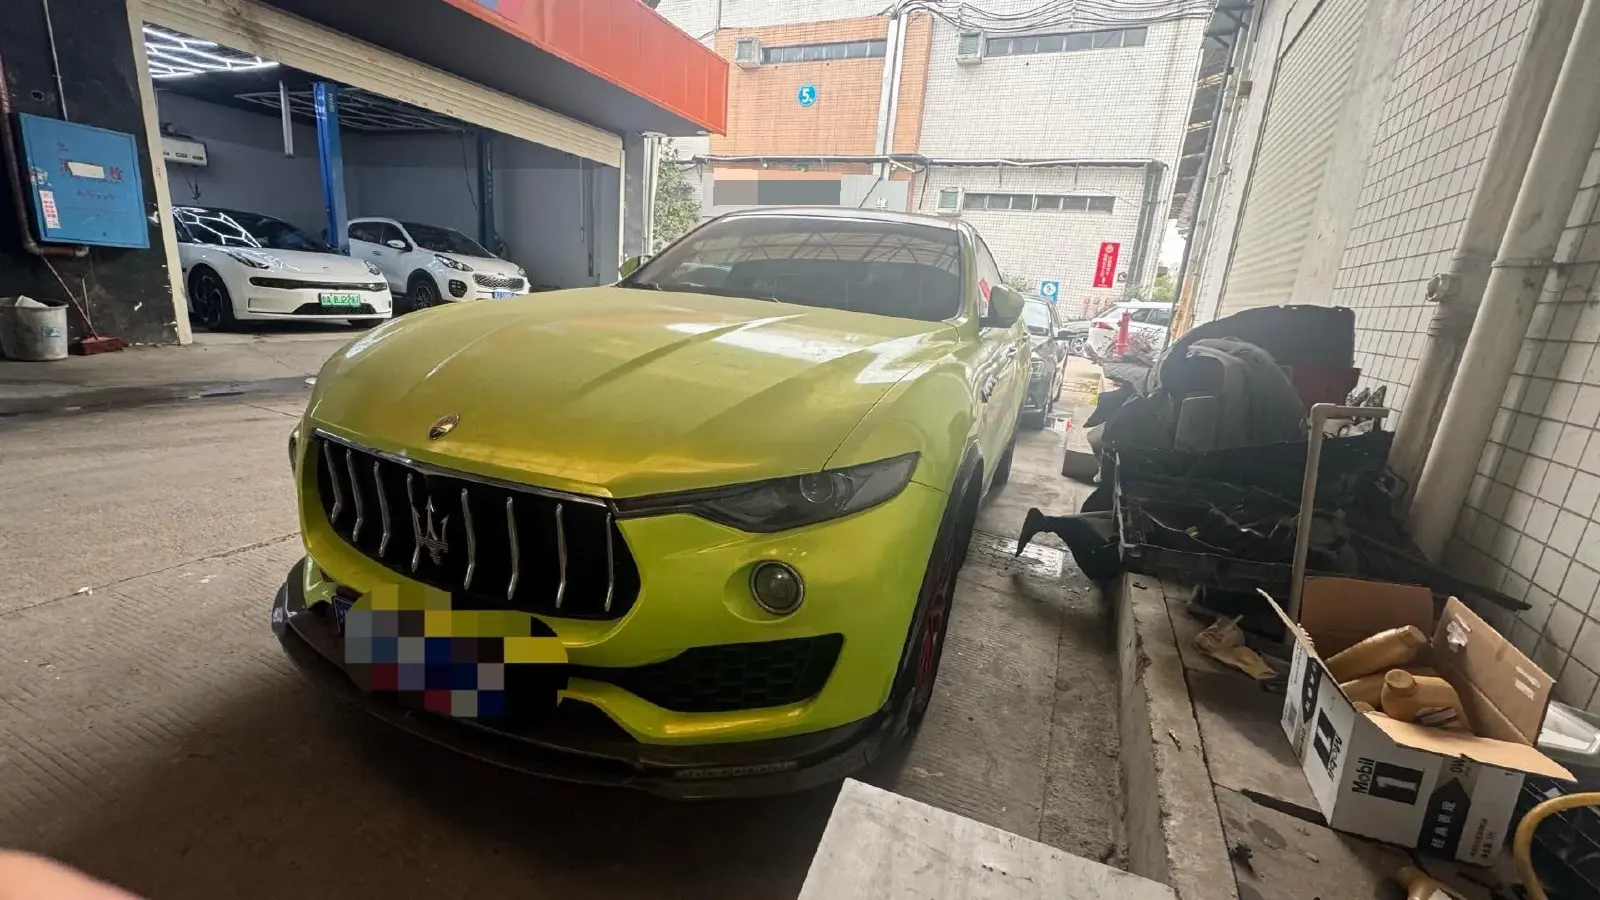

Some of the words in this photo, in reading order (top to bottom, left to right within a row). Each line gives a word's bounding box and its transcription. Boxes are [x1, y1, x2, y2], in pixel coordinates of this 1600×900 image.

[1326, 732, 1343, 783] Mobil
[1351, 757, 1376, 794] Mobil
[1375, 775, 1418, 793] 1
